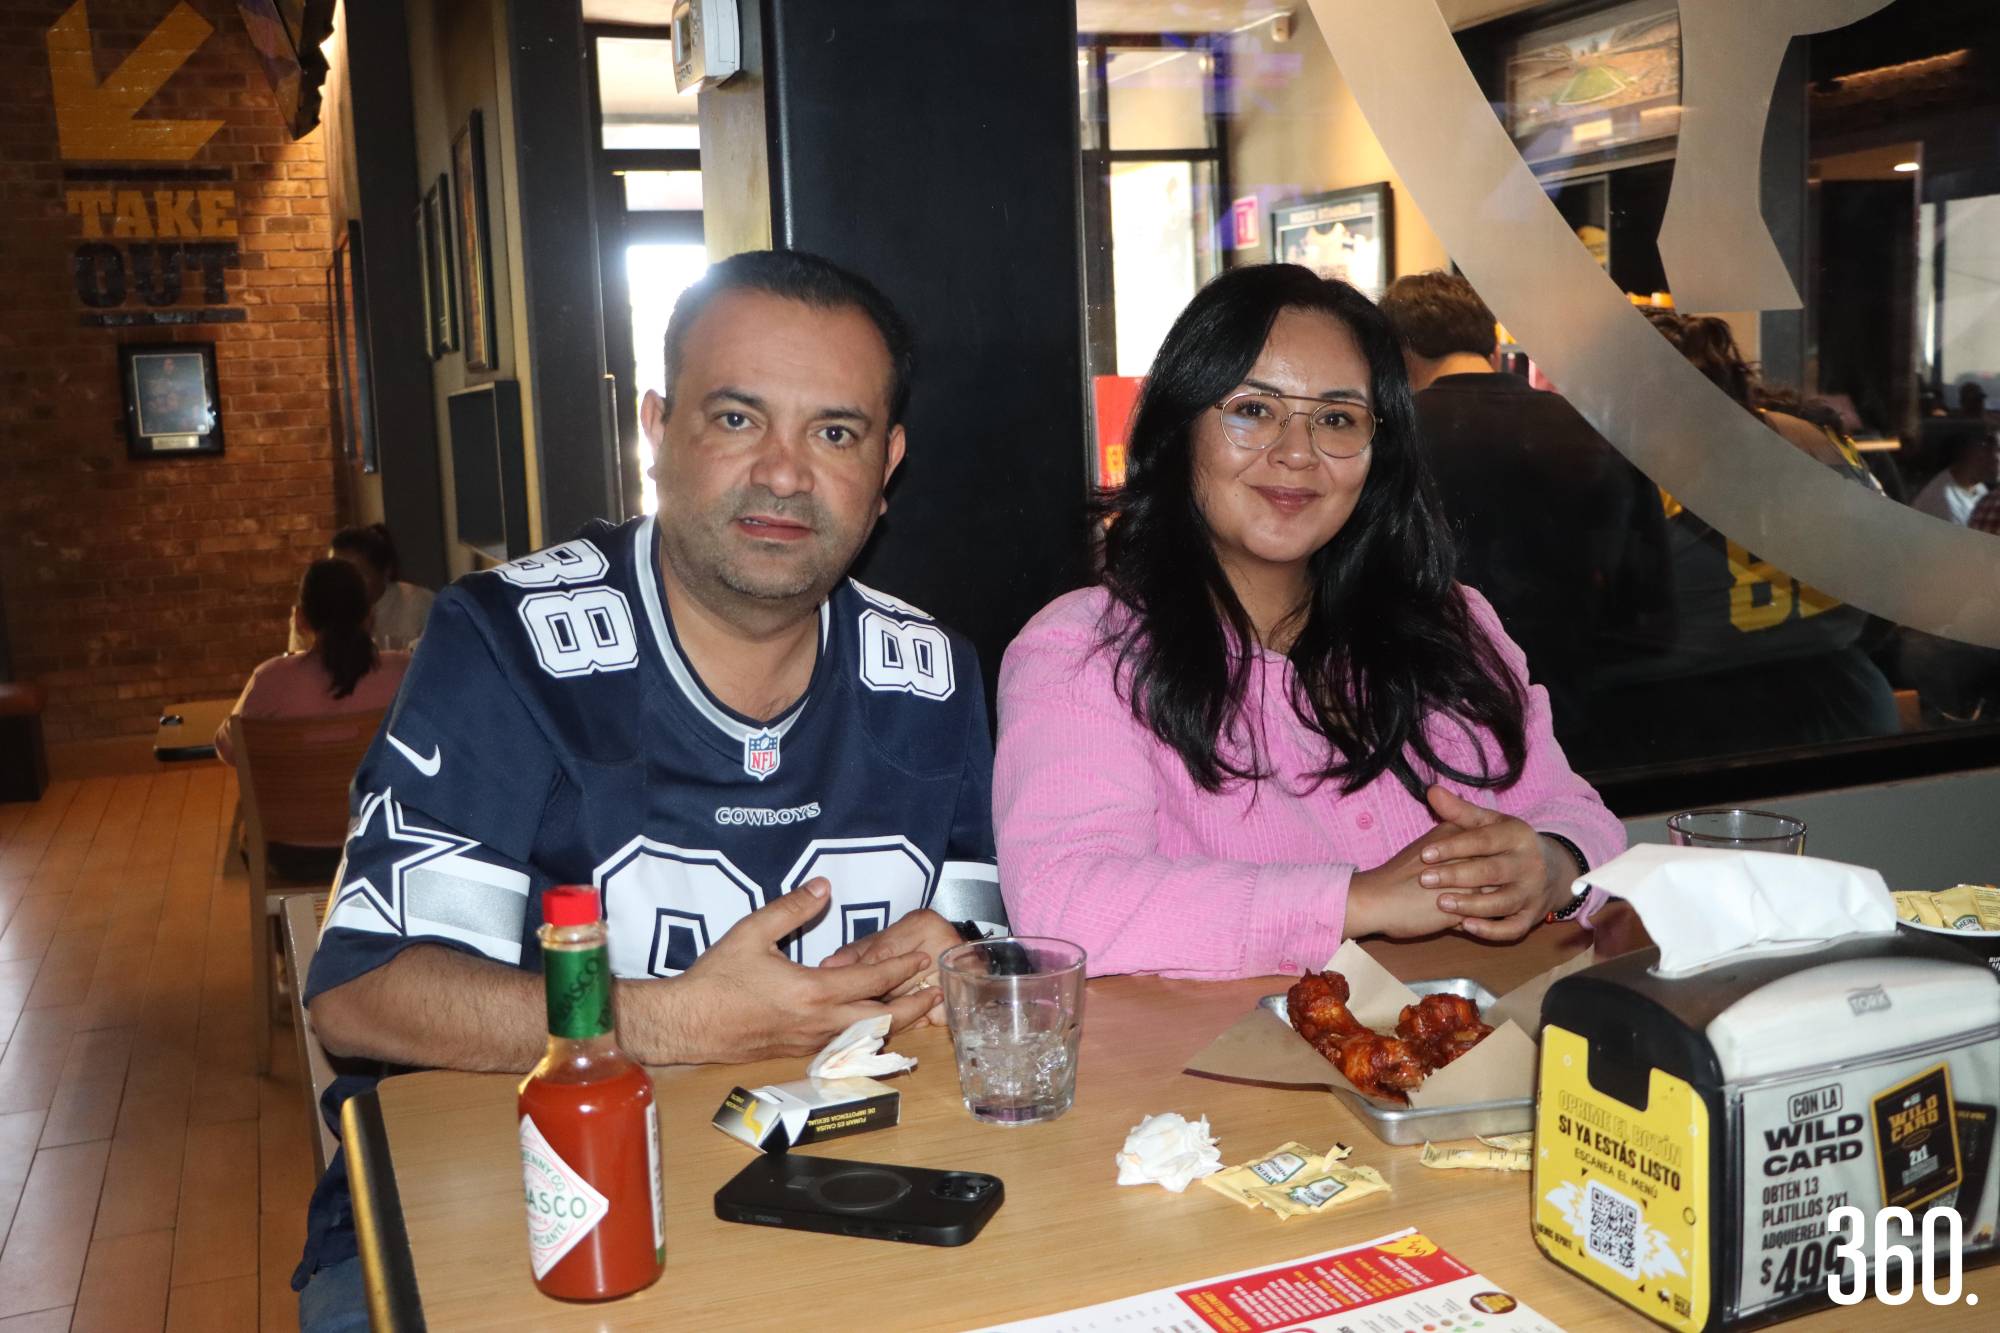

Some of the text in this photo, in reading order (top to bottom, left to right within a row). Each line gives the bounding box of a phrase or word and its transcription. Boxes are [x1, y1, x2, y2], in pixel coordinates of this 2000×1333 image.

[66, 189, 239, 238] TAKE
[74, 241, 241, 308] OUT
[750, 750, 777, 771] NFL
[714, 801, 822, 827] COWBOYS
[1792, 1087, 1838, 1118] CON LA
[1888, 1094, 1939, 1126] WILD
[1763, 1113, 1864, 1152] WILD
[1890, 1110, 1940, 1144] CARD
[1558, 1114, 1682, 1192] SI YA ESTÁS LISTO
[1763, 1139, 1863, 1177] CARD
[1574, 1147, 1659, 1199] ESCANEA EL MENÚ
[1804, 1176, 1819, 1196] 13
[524, 1188, 587, 1219] ASCO
[1762, 1196, 1823, 1228] PLATILLOS
